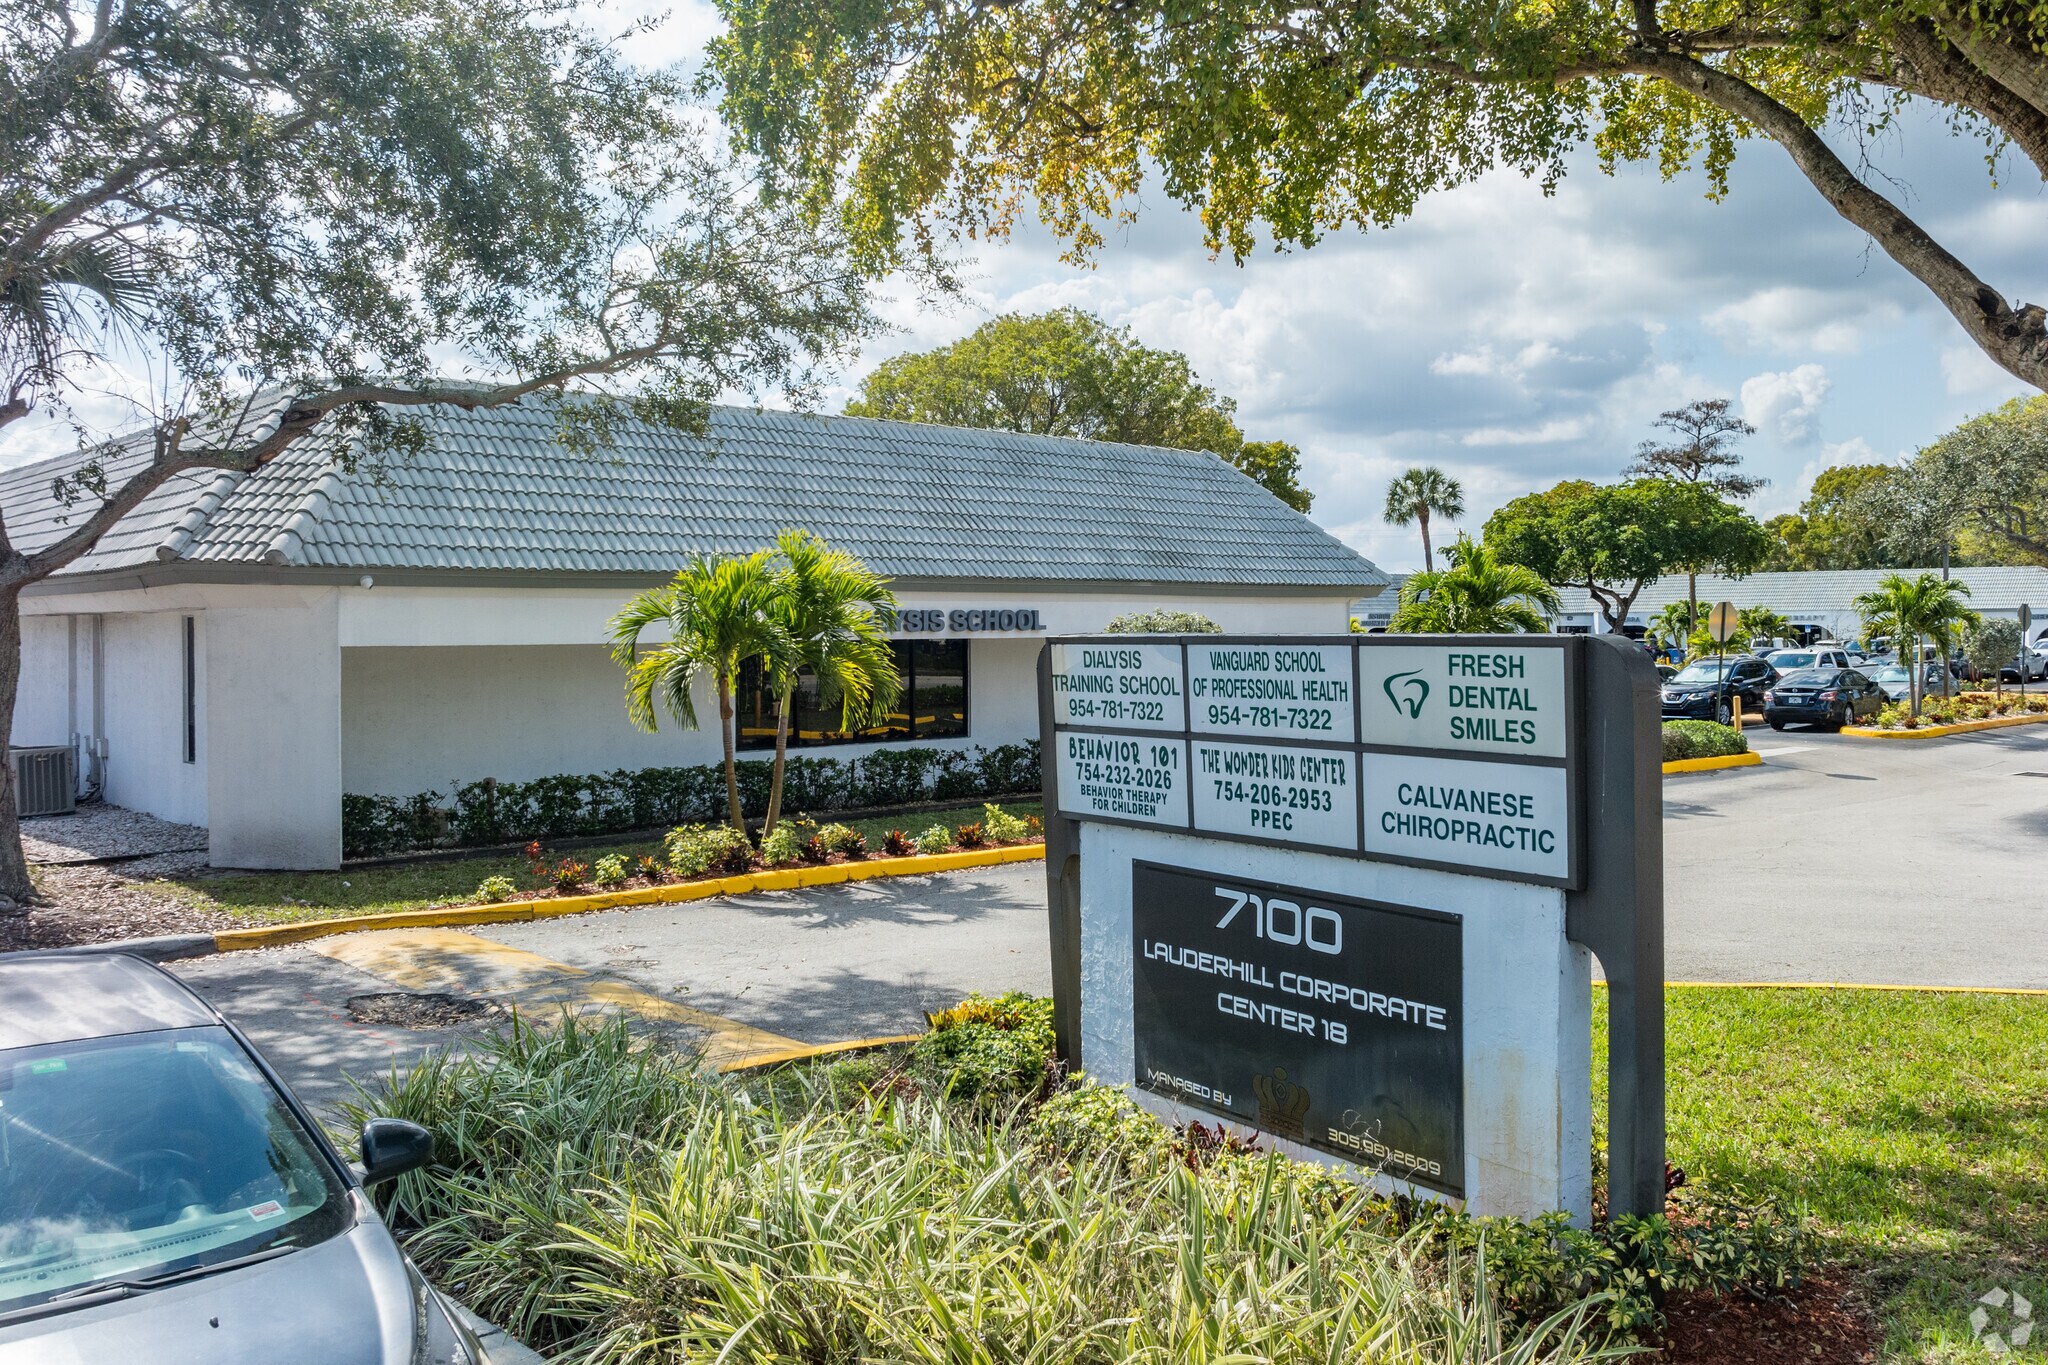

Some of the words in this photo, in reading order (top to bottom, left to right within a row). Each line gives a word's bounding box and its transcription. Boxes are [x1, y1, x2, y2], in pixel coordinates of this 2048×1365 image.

[950, 609, 1047, 633] SCHOOL
[1083, 650, 1142, 670] DIALYSIS
[1209, 651, 1270, 672] VANGUARD
[1275, 652, 1326, 673] SCHOOL
[1448, 654, 1525, 679] FRESH
[1052, 674, 1114, 694] TRAINING
[1119, 676, 1180, 697] SCHOOL
[1193, 678, 1208, 698] OF
[1211, 678, 1298, 701] PROFESSIONAL
[1302, 680, 1348, 702] HEALTH
[1449, 685, 1538, 711] DENTAL
[1069, 699, 1164, 722] 954-781-7322
[1208, 705, 1332, 730] 954-781-7322
[1450, 716, 1536, 744] SMILES
[1069, 736, 1140, 765] BEHAVIOR
[1151, 745, 1178, 770] 101
[1076, 762, 1172, 790] 754-232-2026
[1200, 748, 1220, 774] THE
[1224, 751, 1269, 778] WONDER
[1272, 754, 1295, 781] KIDS
[1300, 756, 1346, 786] CENTER
[1080, 783, 1124, 800] BEHAVIOR
[1126, 789, 1168, 805] THERAPY
[1092, 797, 1109, 811] FOR
[1111, 800, 1156, 817] CHILDREN
[1214, 780, 1332, 812] 754-206-2953
[1397, 783, 1534, 819] CALVANESE
[1251, 808, 1293, 831] PPEC
[1381, 811, 1555, 854] CHIROPRACTIC
[1214, 886, 1343, 955] 7100
[1144, 939, 1274, 988] LAUDERHILL
[1279, 971, 1447, 1031] CORPORATE
[1217, 992, 1315, 1037] CENTER
[1321, 1018, 1348, 1045] 18
[1147, 1067, 1211, 1099] MANAGED
[1213, 1089, 1232, 1106] BY
[1328, 1127, 1441, 1176] 305.9812609
